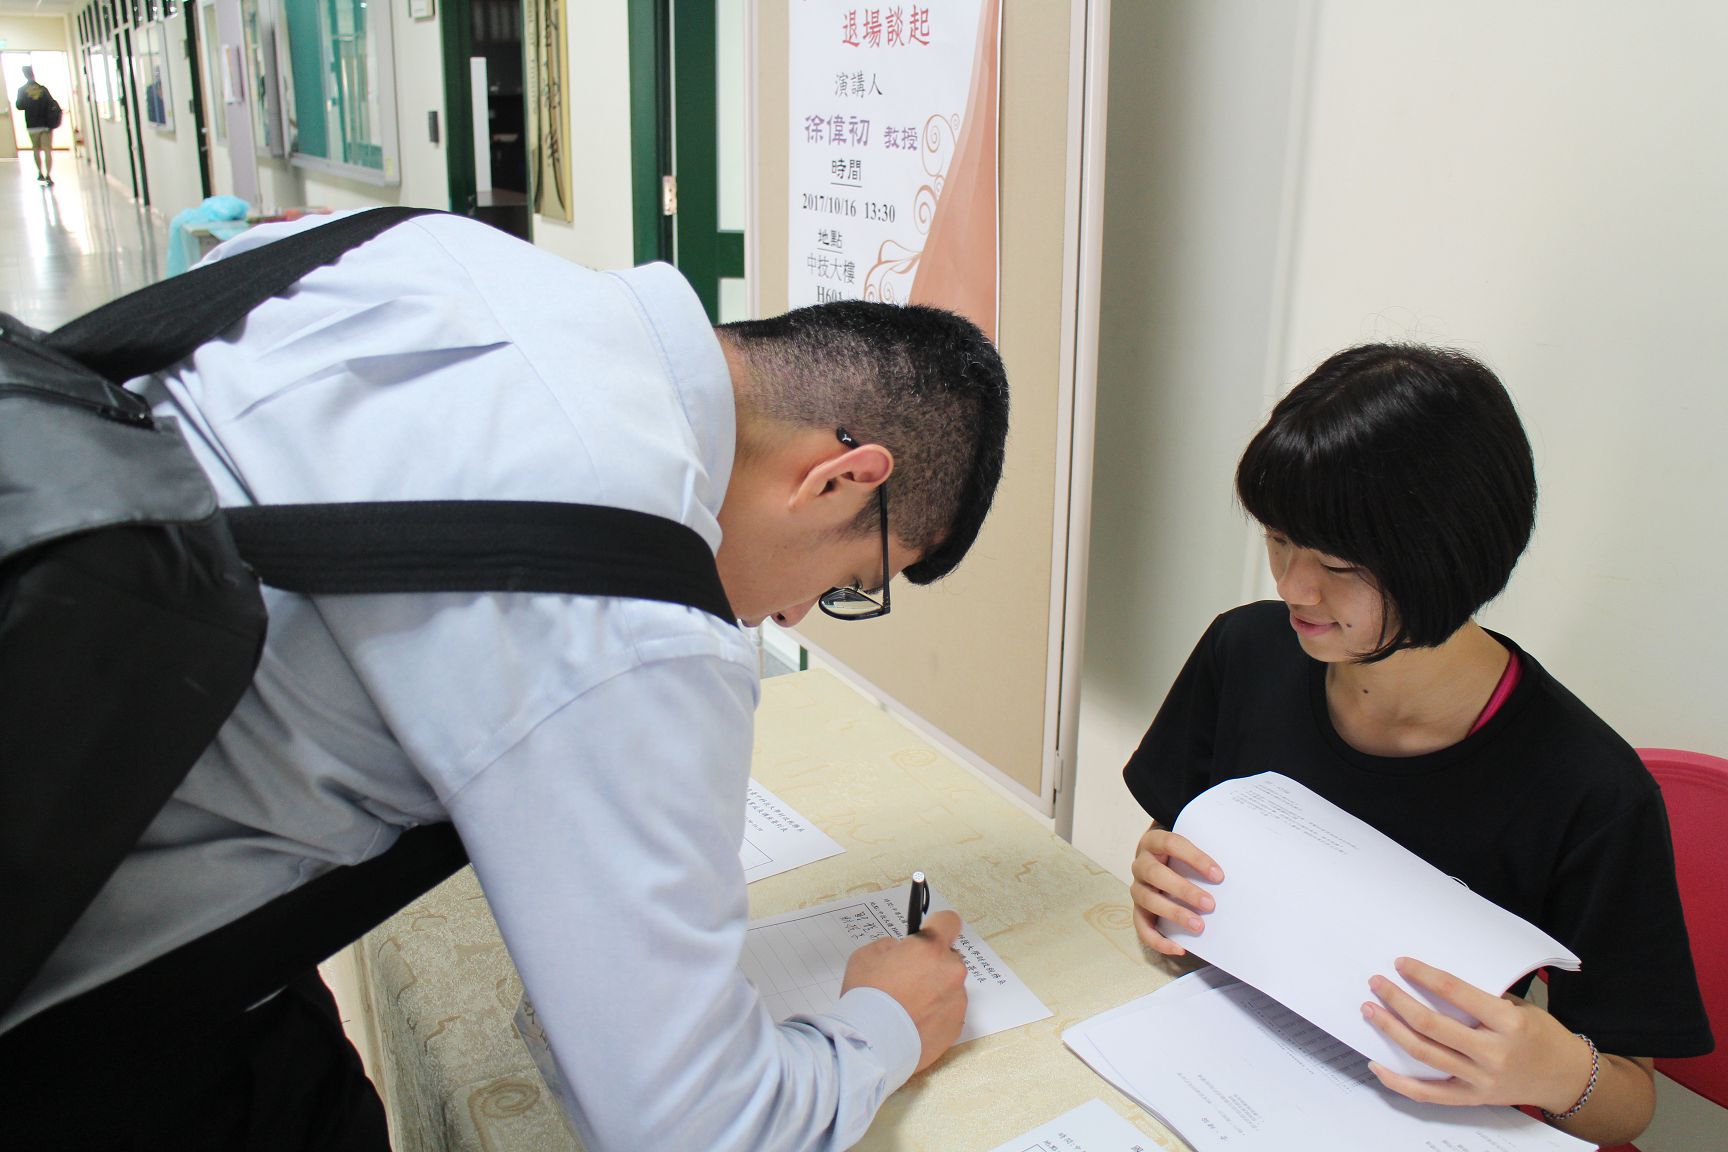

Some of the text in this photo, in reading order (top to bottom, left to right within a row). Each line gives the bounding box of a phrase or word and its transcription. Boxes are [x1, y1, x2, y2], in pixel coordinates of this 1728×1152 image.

[842, 4, 930, 48] 退場談起
[834, 70, 883, 98] 演講人
[805, 114, 918, 151] 徐偉初 教授
[831, 158, 862, 181] 時間
[802, 192, 896, 223] 2017/10/16 13:30
[818, 229, 843, 249] 地點
[807, 252, 856, 284] 中技大樓
